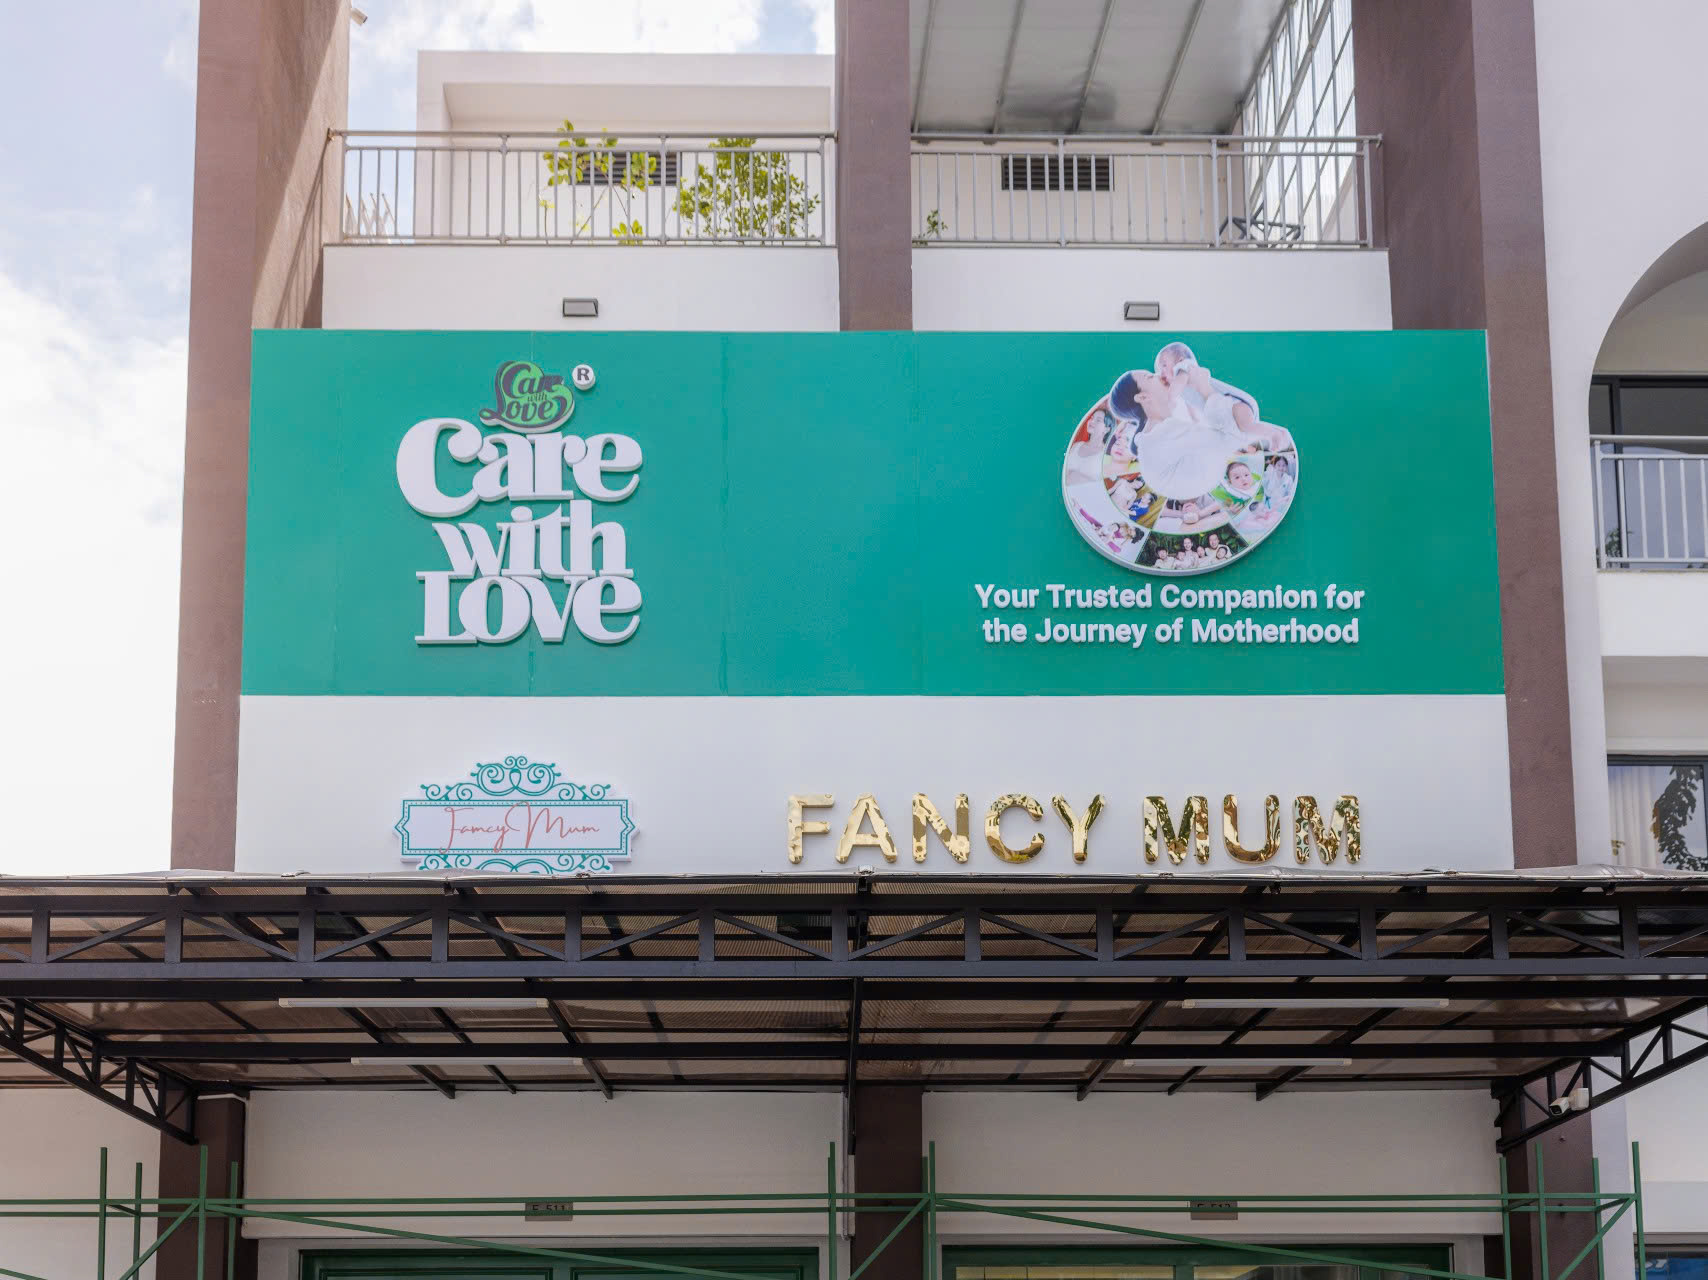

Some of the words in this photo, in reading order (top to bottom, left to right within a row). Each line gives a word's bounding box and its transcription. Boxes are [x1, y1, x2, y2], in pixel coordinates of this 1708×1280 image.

[501, 362, 564, 399] Care
[396, 417, 643, 518] Care
[432, 499, 634, 579] with
[415, 571, 643, 644] Love
[974, 583, 1039, 609] Your
[1046, 583, 1152, 609] Trusted
[1159, 583, 1317, 615] Companion
[1324, 583, 1365, 609] for
[982, 617, 1027, 643] the
[1035, 617, 1147, 648] Journey
[1154, 617, 1184, 643] of
[1191, 617, 1359, 643] Motherhood
[504, 801, 600, 849] Mum
[787, 792, 1106, 865] FANCY
[1143, 794, 1362, 865] MUM
